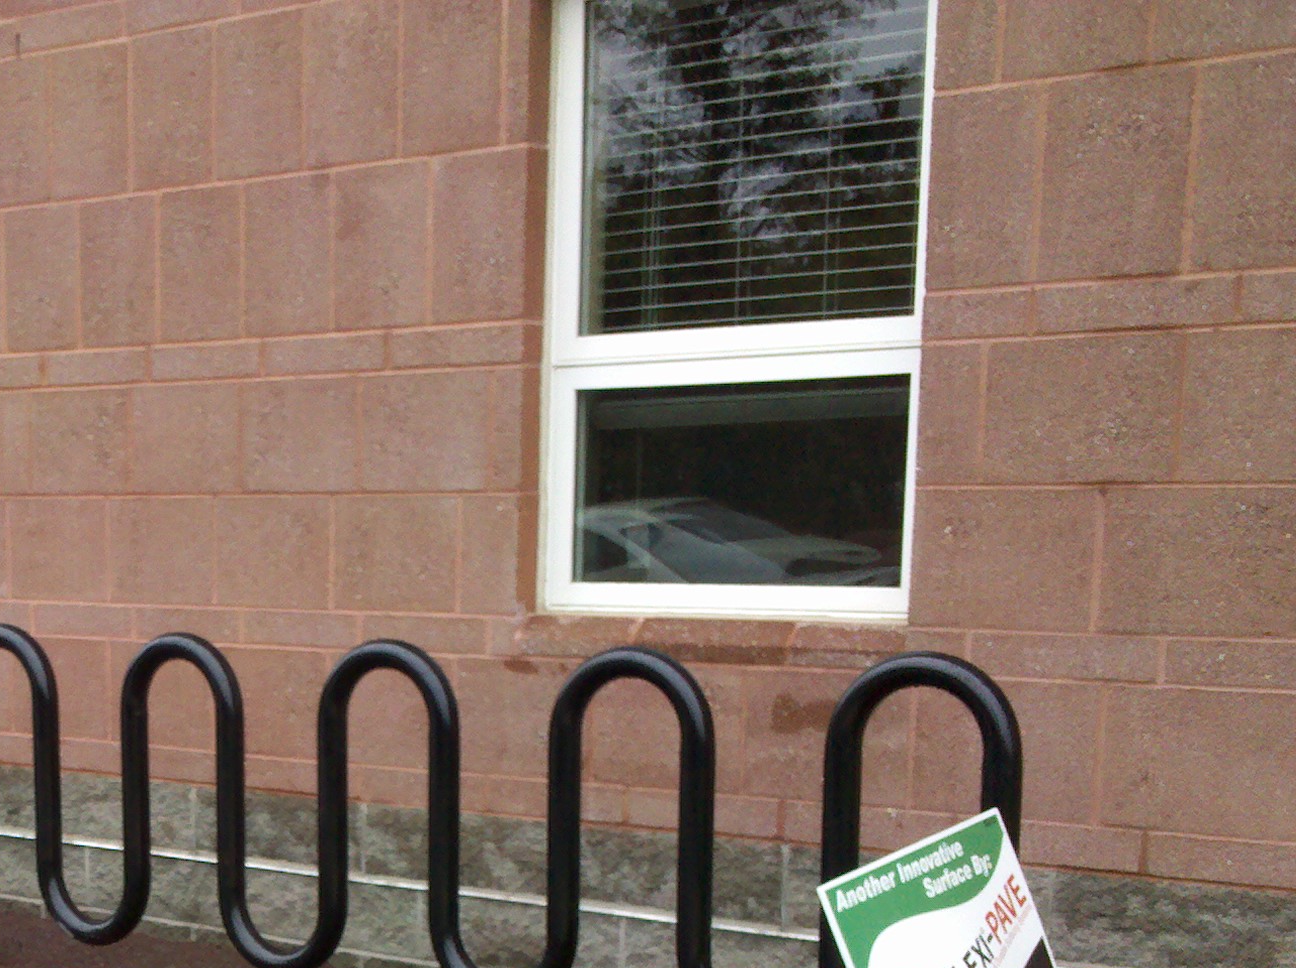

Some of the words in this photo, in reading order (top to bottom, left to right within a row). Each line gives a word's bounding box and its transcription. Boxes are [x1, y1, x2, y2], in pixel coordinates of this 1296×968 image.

[836, 870, 897, 913] Another
[896, 841, 965, 884] Innovative
[922, 865, 974, 899] Surface
[969, 853, 993, 878] By:
